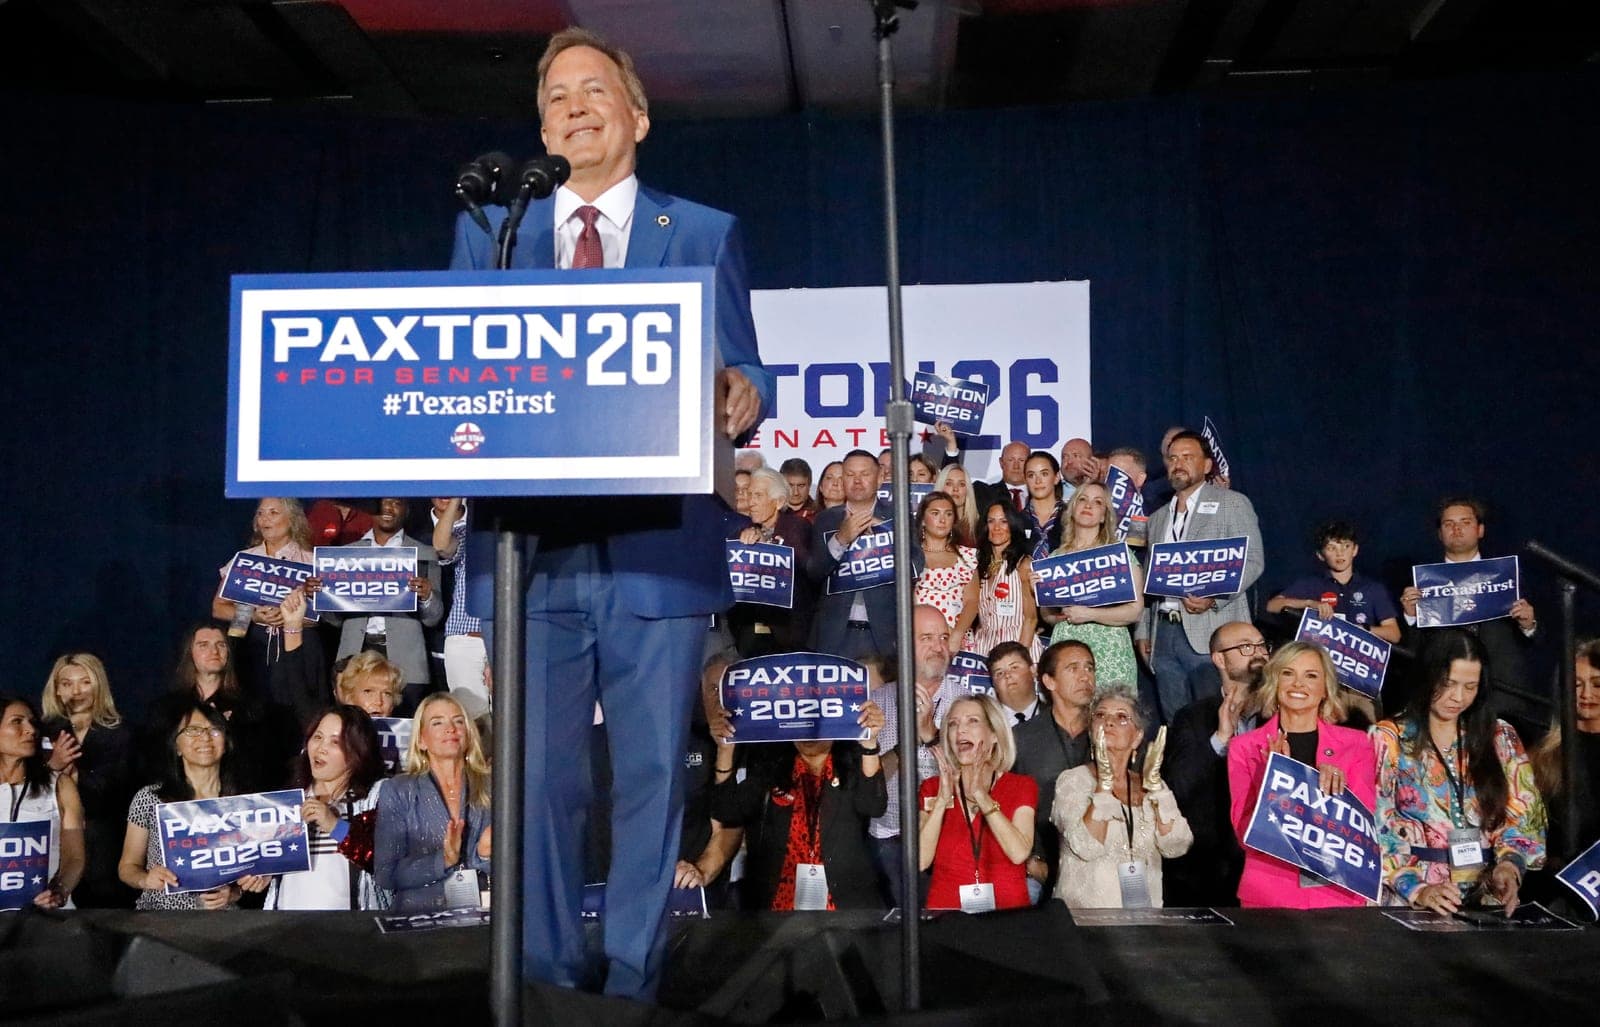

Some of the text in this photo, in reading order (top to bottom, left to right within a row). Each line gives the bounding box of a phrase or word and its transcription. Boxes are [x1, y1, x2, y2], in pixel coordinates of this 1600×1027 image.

[271, 311, 673, 386] PAXTON 26
[300, 365, 548, 386] FOR SENATE
[382, 389, 556, 416] #TexasFirst
[915, 379, 986, 405] PAXTON
[923, 401, 972, 421] 2026
[318, 557, 414, 573] PAXTON
[727, 549, 791, 569] XTON
[838, 555, 895, 577] 2026
[1036, 552, 1127, 582] PAXTON
[1155, 546, 1245, 566] PAXTON
[334, 581, 400, 596] 2026
[1054, 576, 1117, 599] 2026
[1166, 569, 1228, 587] 2026
[1420, 578, 1515, 599] #TexasFirst
[1305, 618, 1388, 663] PAXTON
[728, 664, 864, 686] PAXTON
[780, 684, 865, 697] SENATE
[750, 698, 844, 721] 2026
[1270, 769, 1379, 844] PAXTON
[164, 804, 302, 839] PAXTON
[1281, 814, 1366, 869] 2026
[190, 840, 284, 870] 2026
